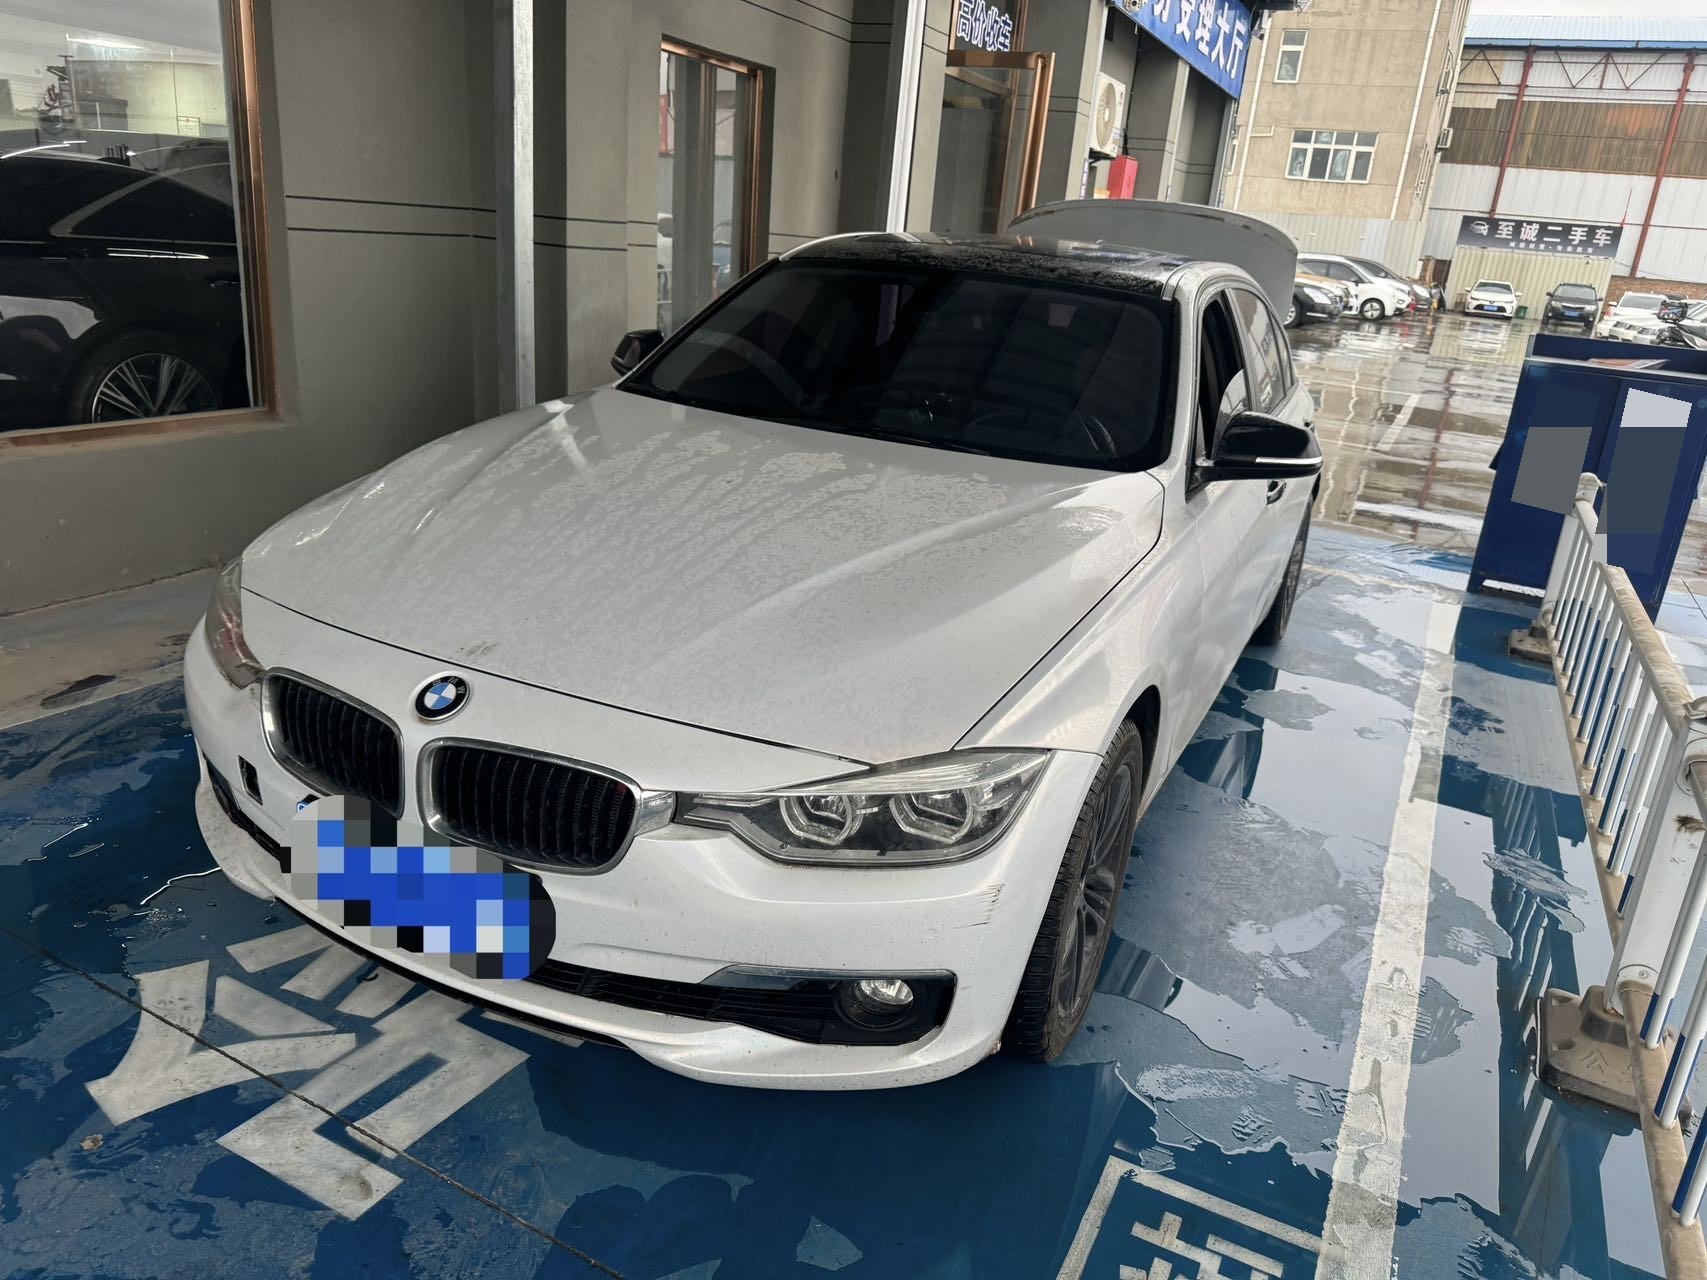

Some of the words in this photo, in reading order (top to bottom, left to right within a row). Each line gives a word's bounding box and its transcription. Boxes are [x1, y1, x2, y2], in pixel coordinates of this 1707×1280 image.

[957, 0, 1013, 52] 高价收车
[1153, 0, 1245, 80] 受理大厅
[1494, 221, 1614, 248] 至诚二手车
